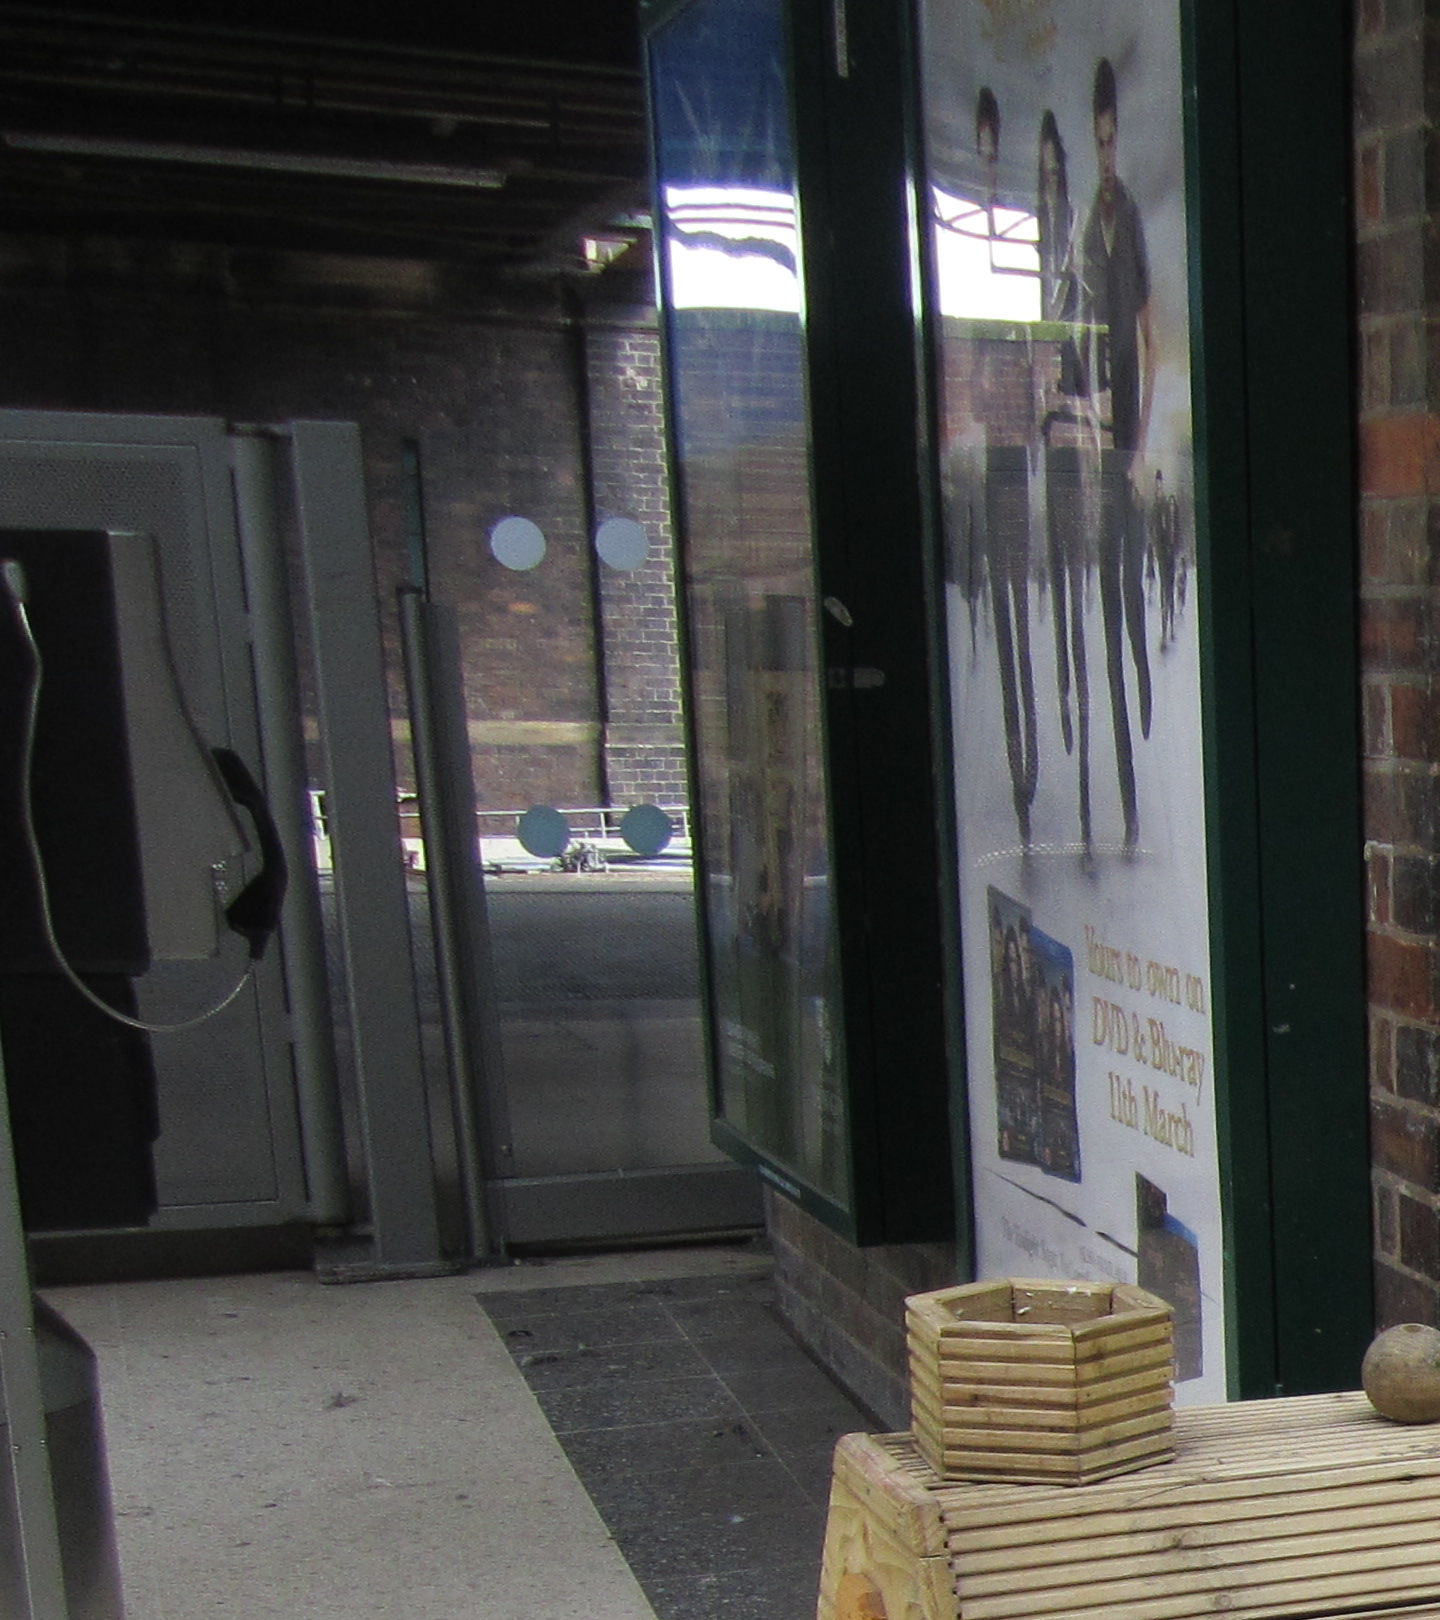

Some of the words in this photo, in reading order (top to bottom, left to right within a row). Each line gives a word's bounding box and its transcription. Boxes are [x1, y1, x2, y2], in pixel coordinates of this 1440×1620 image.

[1084, 923, 1123, 984] Yours
[1126, 951, 1142, 991] to
[1147, 960, 1181, 1005] own
[1186, 974, 1206, 1014] on
[1092, 996, 1129, 1056] DVD
[1132, 1011, 1148, 1065] &
[1148, 1017, 1205, 1107] Blu-ray
[1108, 1071, 1138, 1130] 11th
[1143, 1085, 1195, 1158] March
